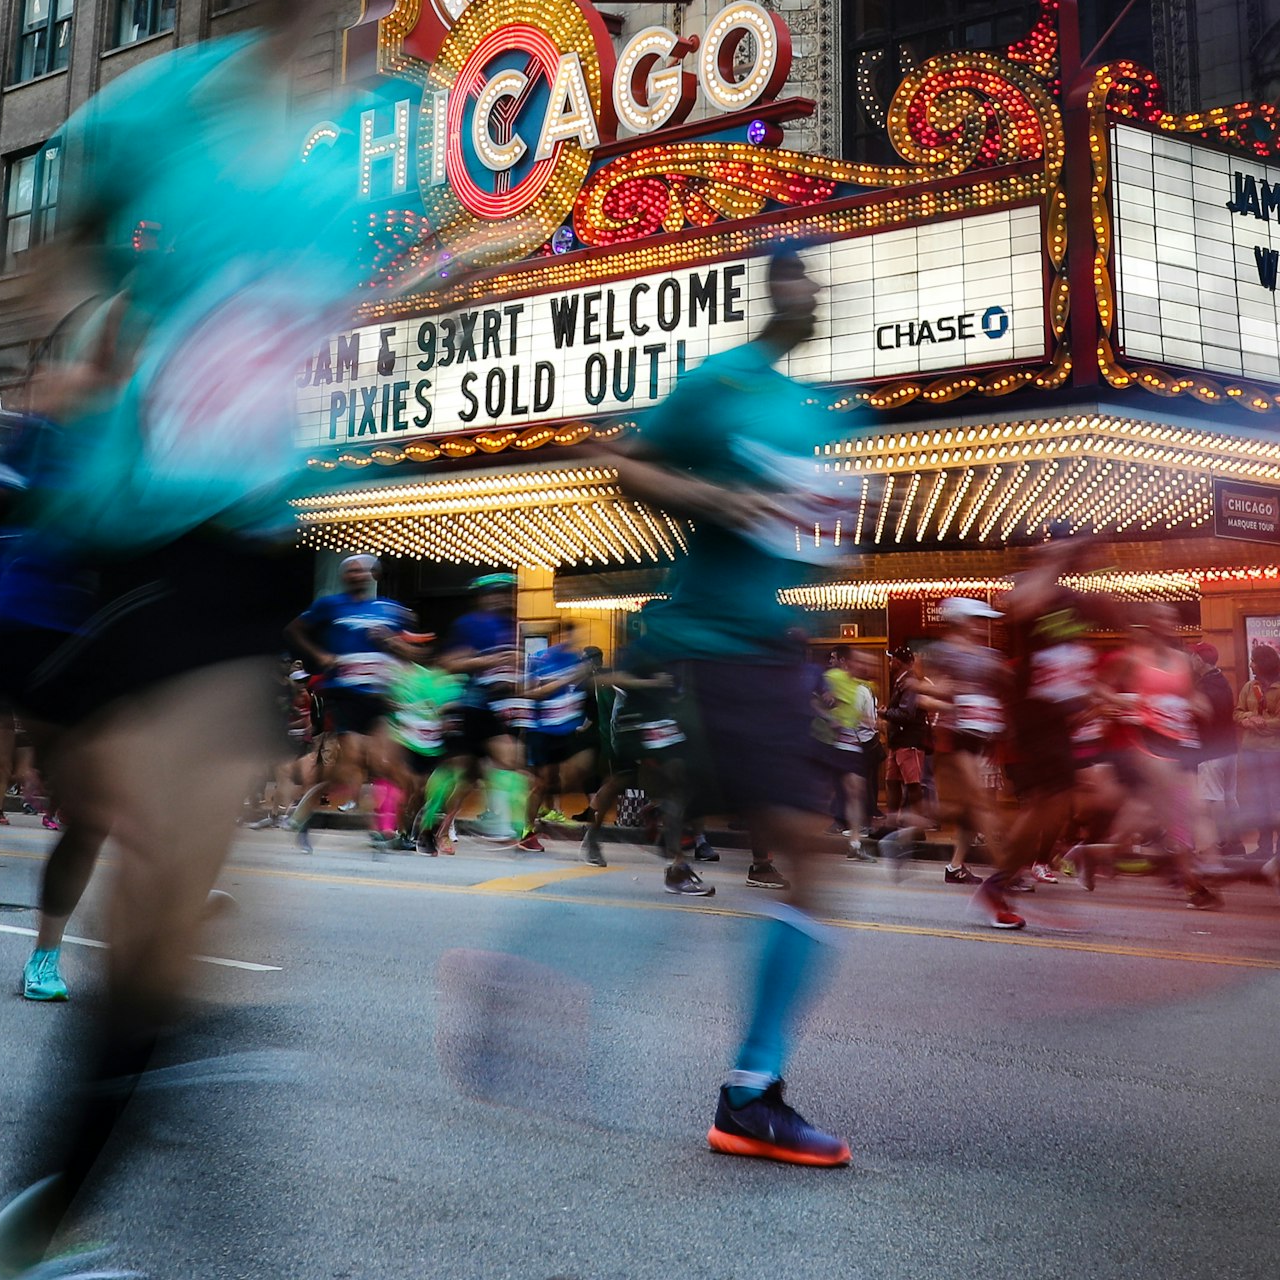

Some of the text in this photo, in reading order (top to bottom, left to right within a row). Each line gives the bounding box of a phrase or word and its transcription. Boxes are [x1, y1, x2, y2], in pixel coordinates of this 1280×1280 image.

[296, 264, 746, 388] JAM & 93XRT WELCOME
[876, 313, 977, 351] CHASE
[329, 339, 688, 441] PIXIES SOLD OUT!
[1227, 518, 1275, 533] MARQUEE TOUR
[1228, 499, 1273, 516] CHICAGO
